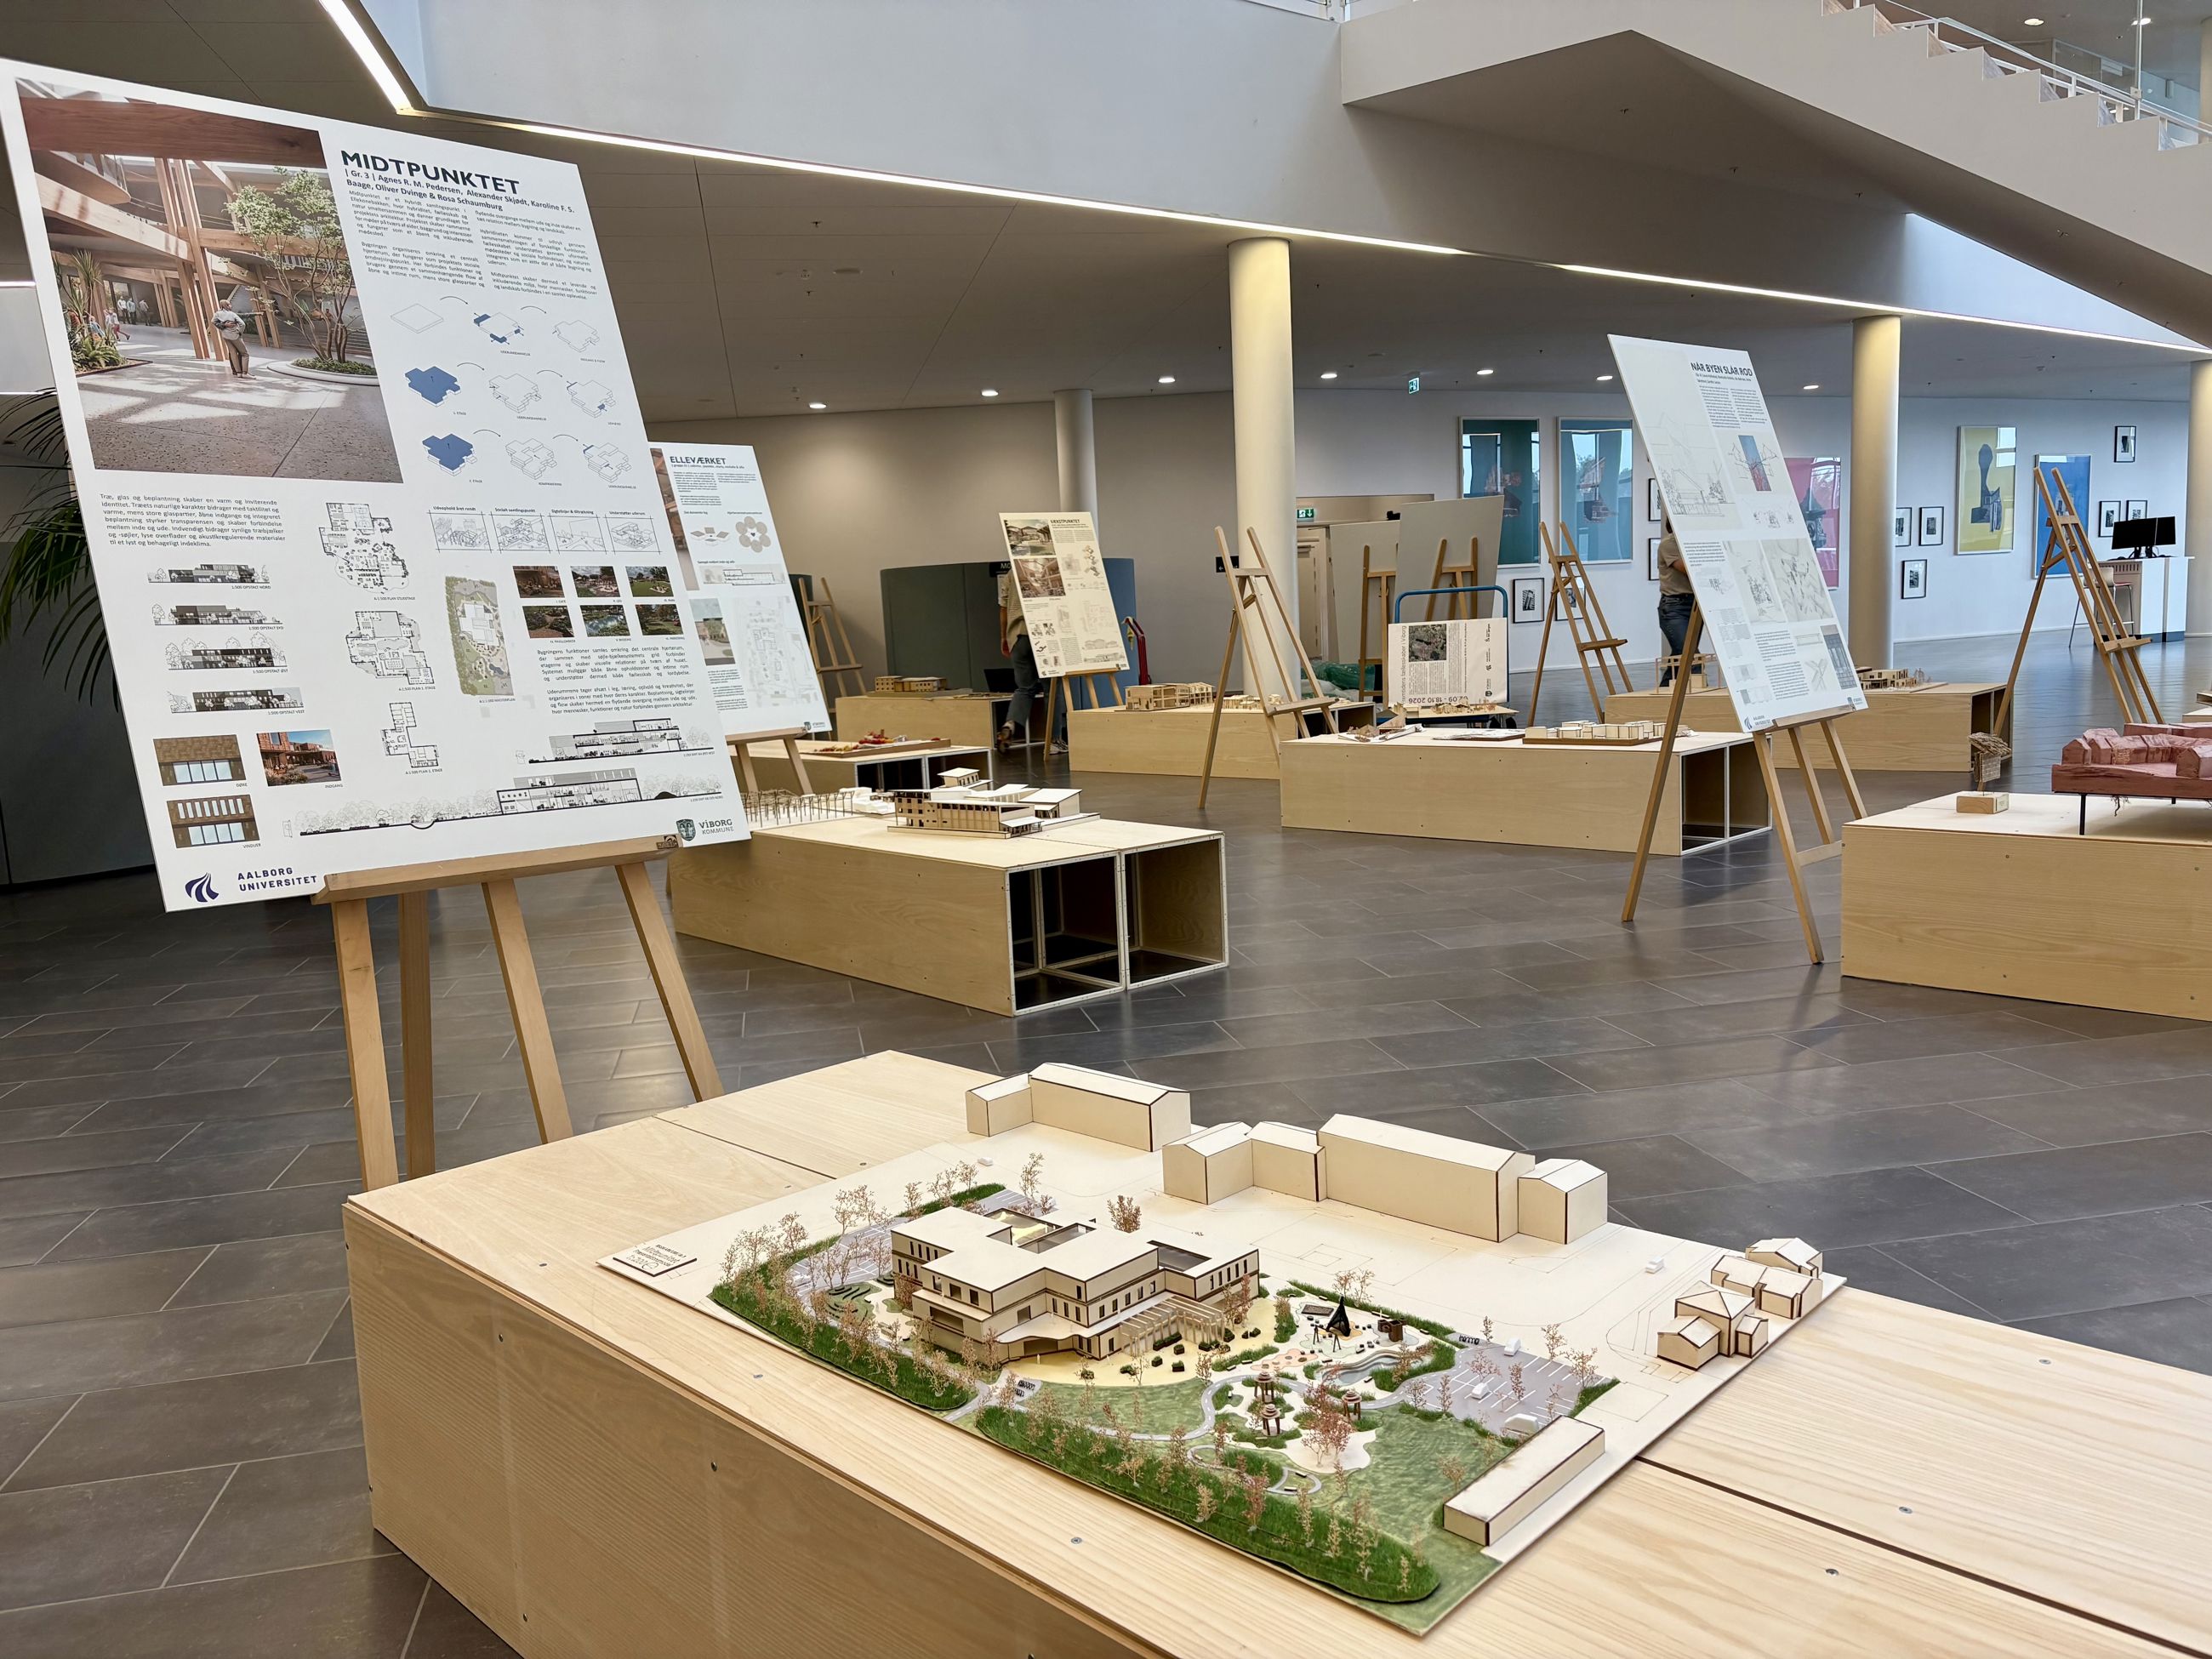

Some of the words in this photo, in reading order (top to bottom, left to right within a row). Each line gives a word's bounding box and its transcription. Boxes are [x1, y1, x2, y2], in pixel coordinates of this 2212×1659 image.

[341, 151, 520, 195] MIDTPUNKTET
[347, 180, 373, 191] Baage,
[375, 184, 399, 193] Oliver
[401, 188, 427, 199] Dvinge
[437, 194, 456, 202] Rosa
[457, 197, 503, 212] Schaumburg
[379, 175, 402, 184] Agnes
[425, 183, 463, 196] Pedersen,
[467, 190, 503, 201] Alexander
[505, 196, 530, 207] Skjødt,
[531, 201, 560, 211] Karoline
[1706, 364, 1723, 373] BYEN
[1739, 368, 1753, 376] ROD
[670, 456, 726, 465] ELLEVÆRKET
[702, 826, 734, 835] KOMMUNE
[238, 868, 293, 881] AALBORG
[239, 875, 316, 892] UNIVERSITET
